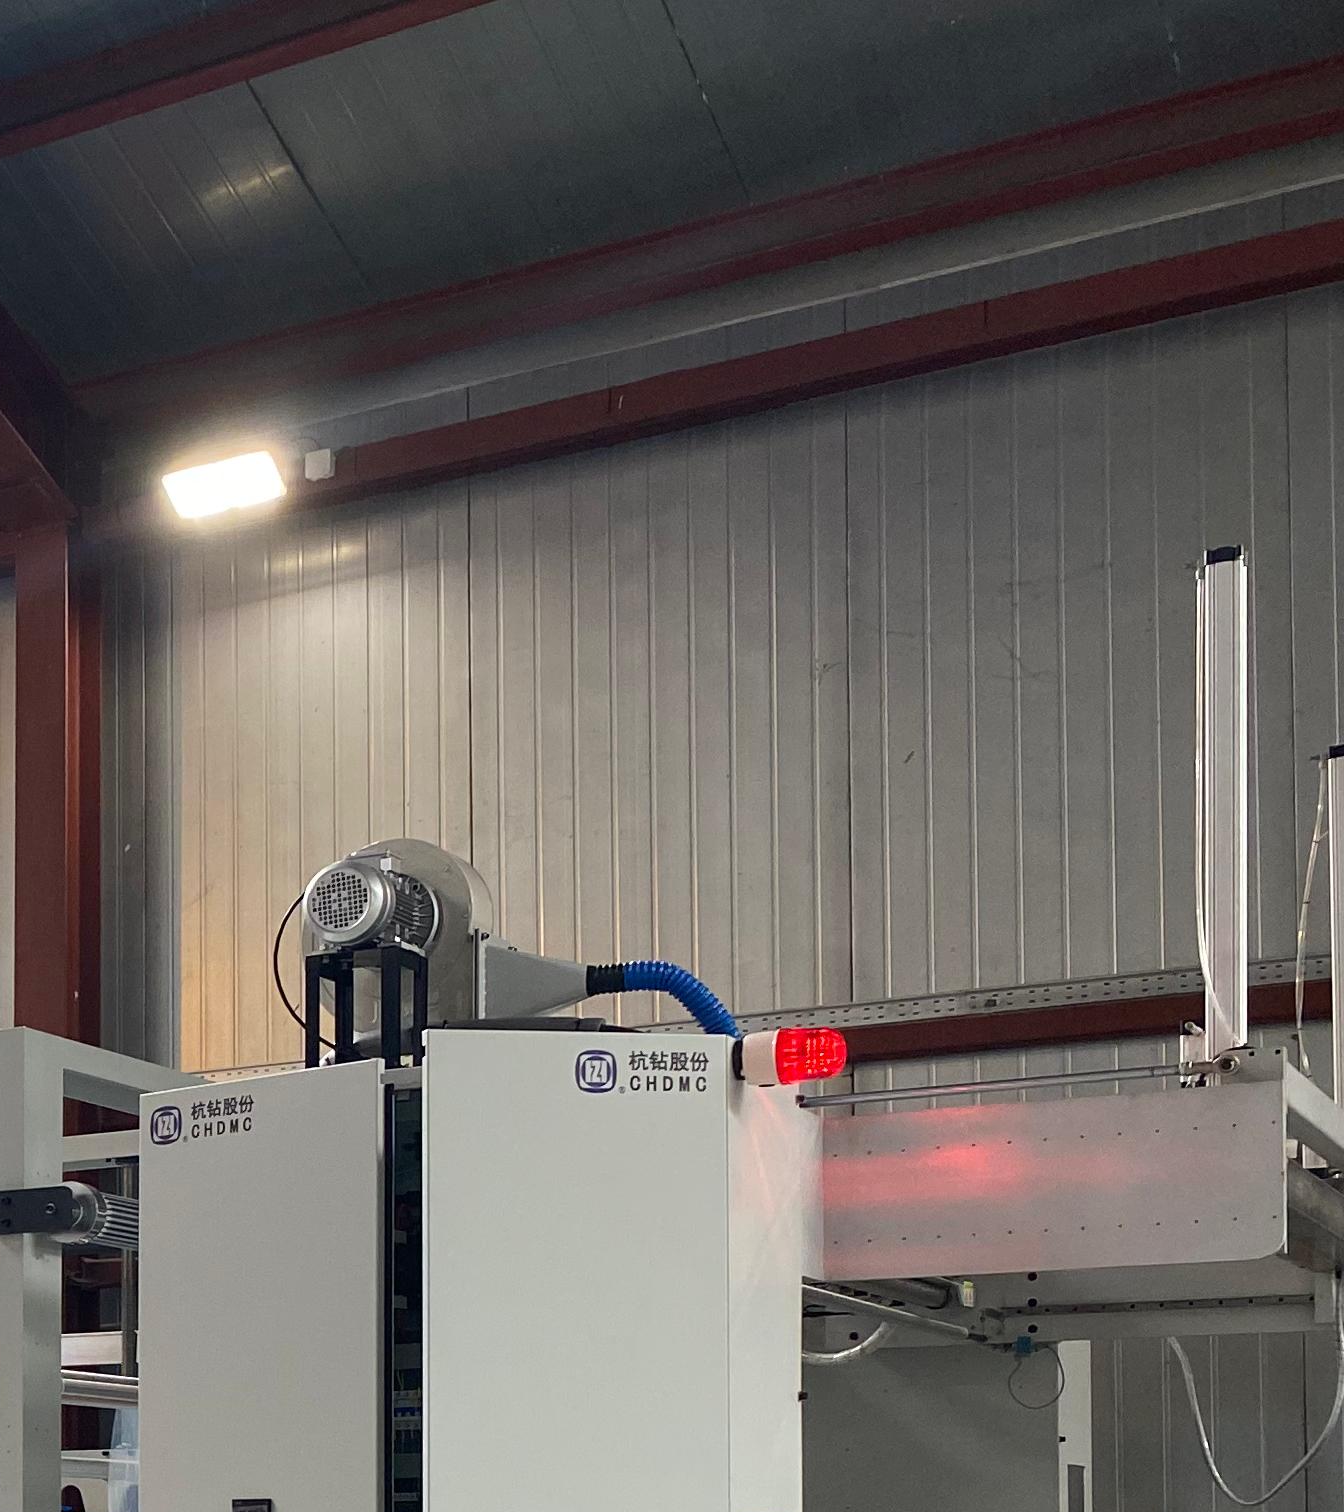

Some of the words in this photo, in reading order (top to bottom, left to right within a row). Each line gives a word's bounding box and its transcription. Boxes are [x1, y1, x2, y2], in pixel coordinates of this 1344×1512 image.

[628, 1050, 709, 1072] 杭钻股份
[629, 1075, 707, 1092] CHDMC
[190, 1094, 254, 1121] 杭钻股份
[191, 1117, 252, 1138] CHDMC
